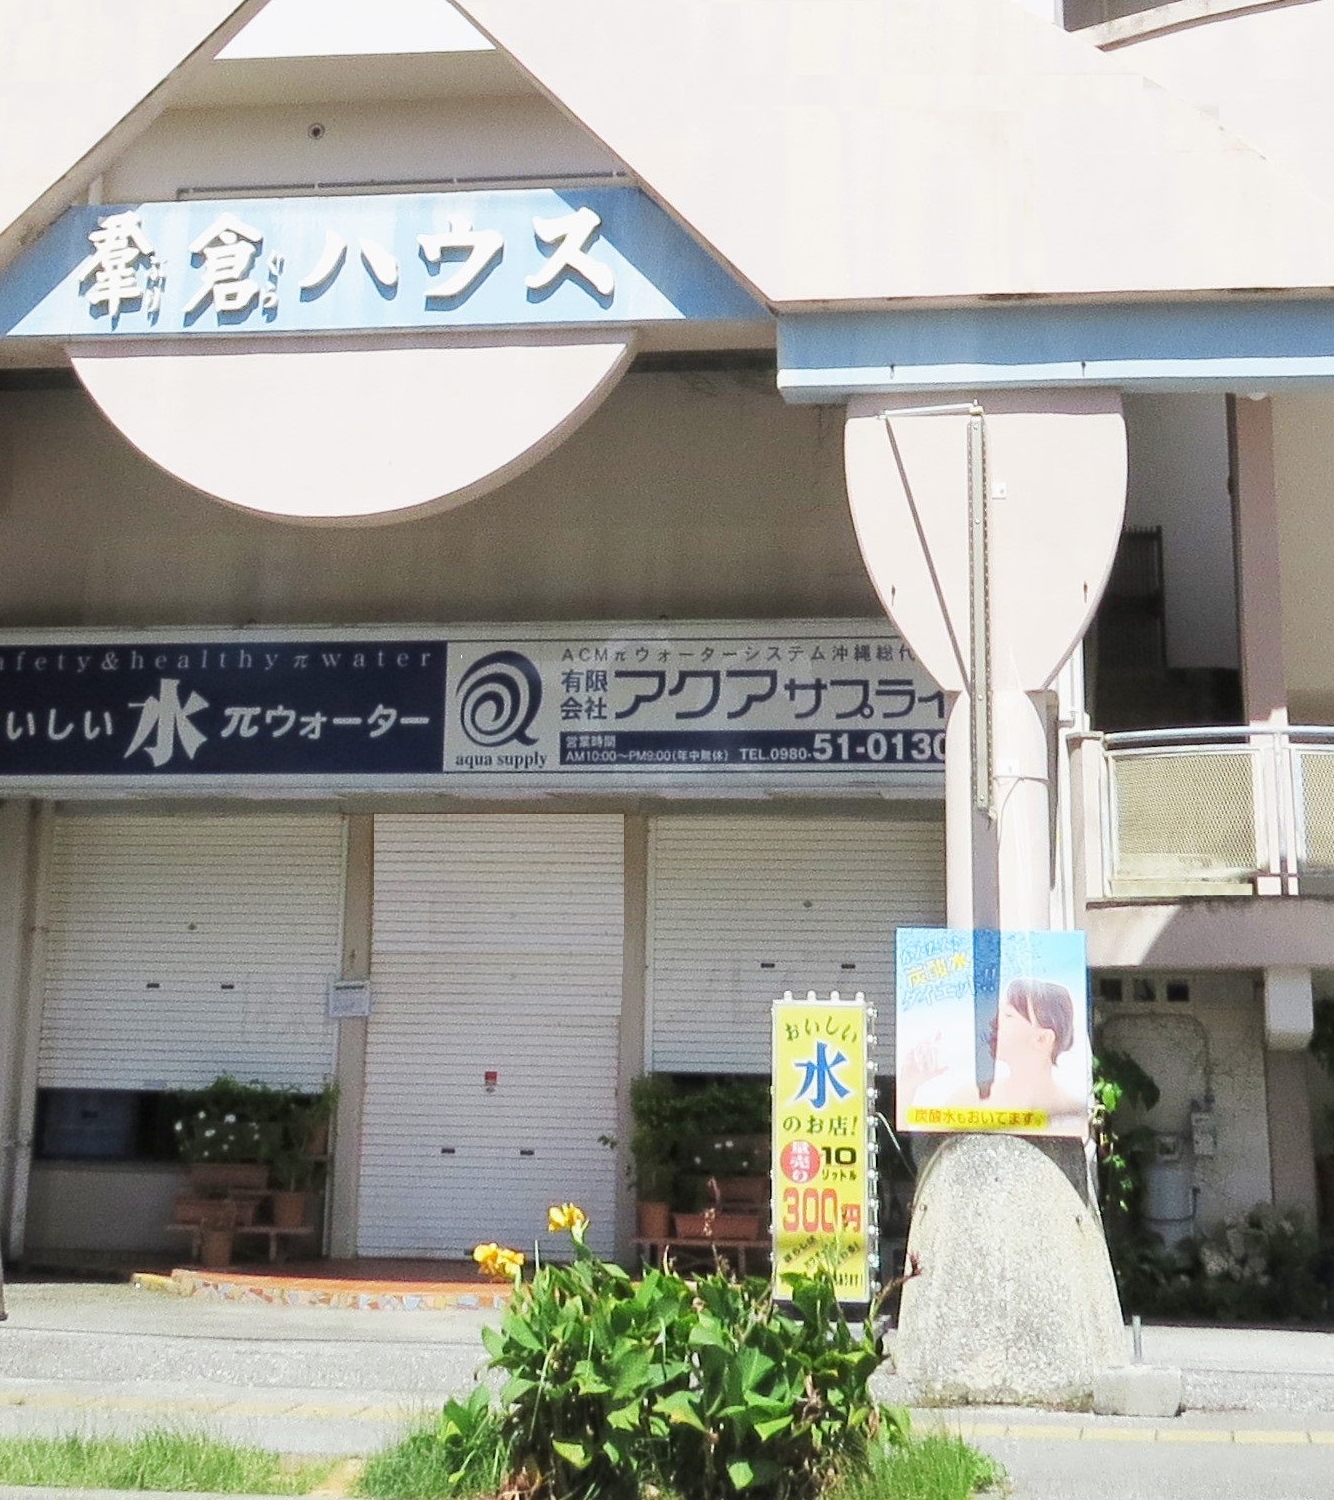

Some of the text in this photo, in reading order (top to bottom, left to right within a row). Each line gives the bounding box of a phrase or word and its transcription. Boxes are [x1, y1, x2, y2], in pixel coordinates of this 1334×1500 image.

[561, 669, 608, 693] 有限
[614, 670, 945, 720] アクアサプライ
[560, 699, 608, 720] 会社
[566, 735, 616, 748] 営業時間
[455, 752, 548, 769] aqua supply
[785, 1015, 857, 1043] おいしい
[794, 1041, 850, 1108] 水
[821, 1146, 857, 1165] 10
[822, 1169, 857, 1181] リットル
